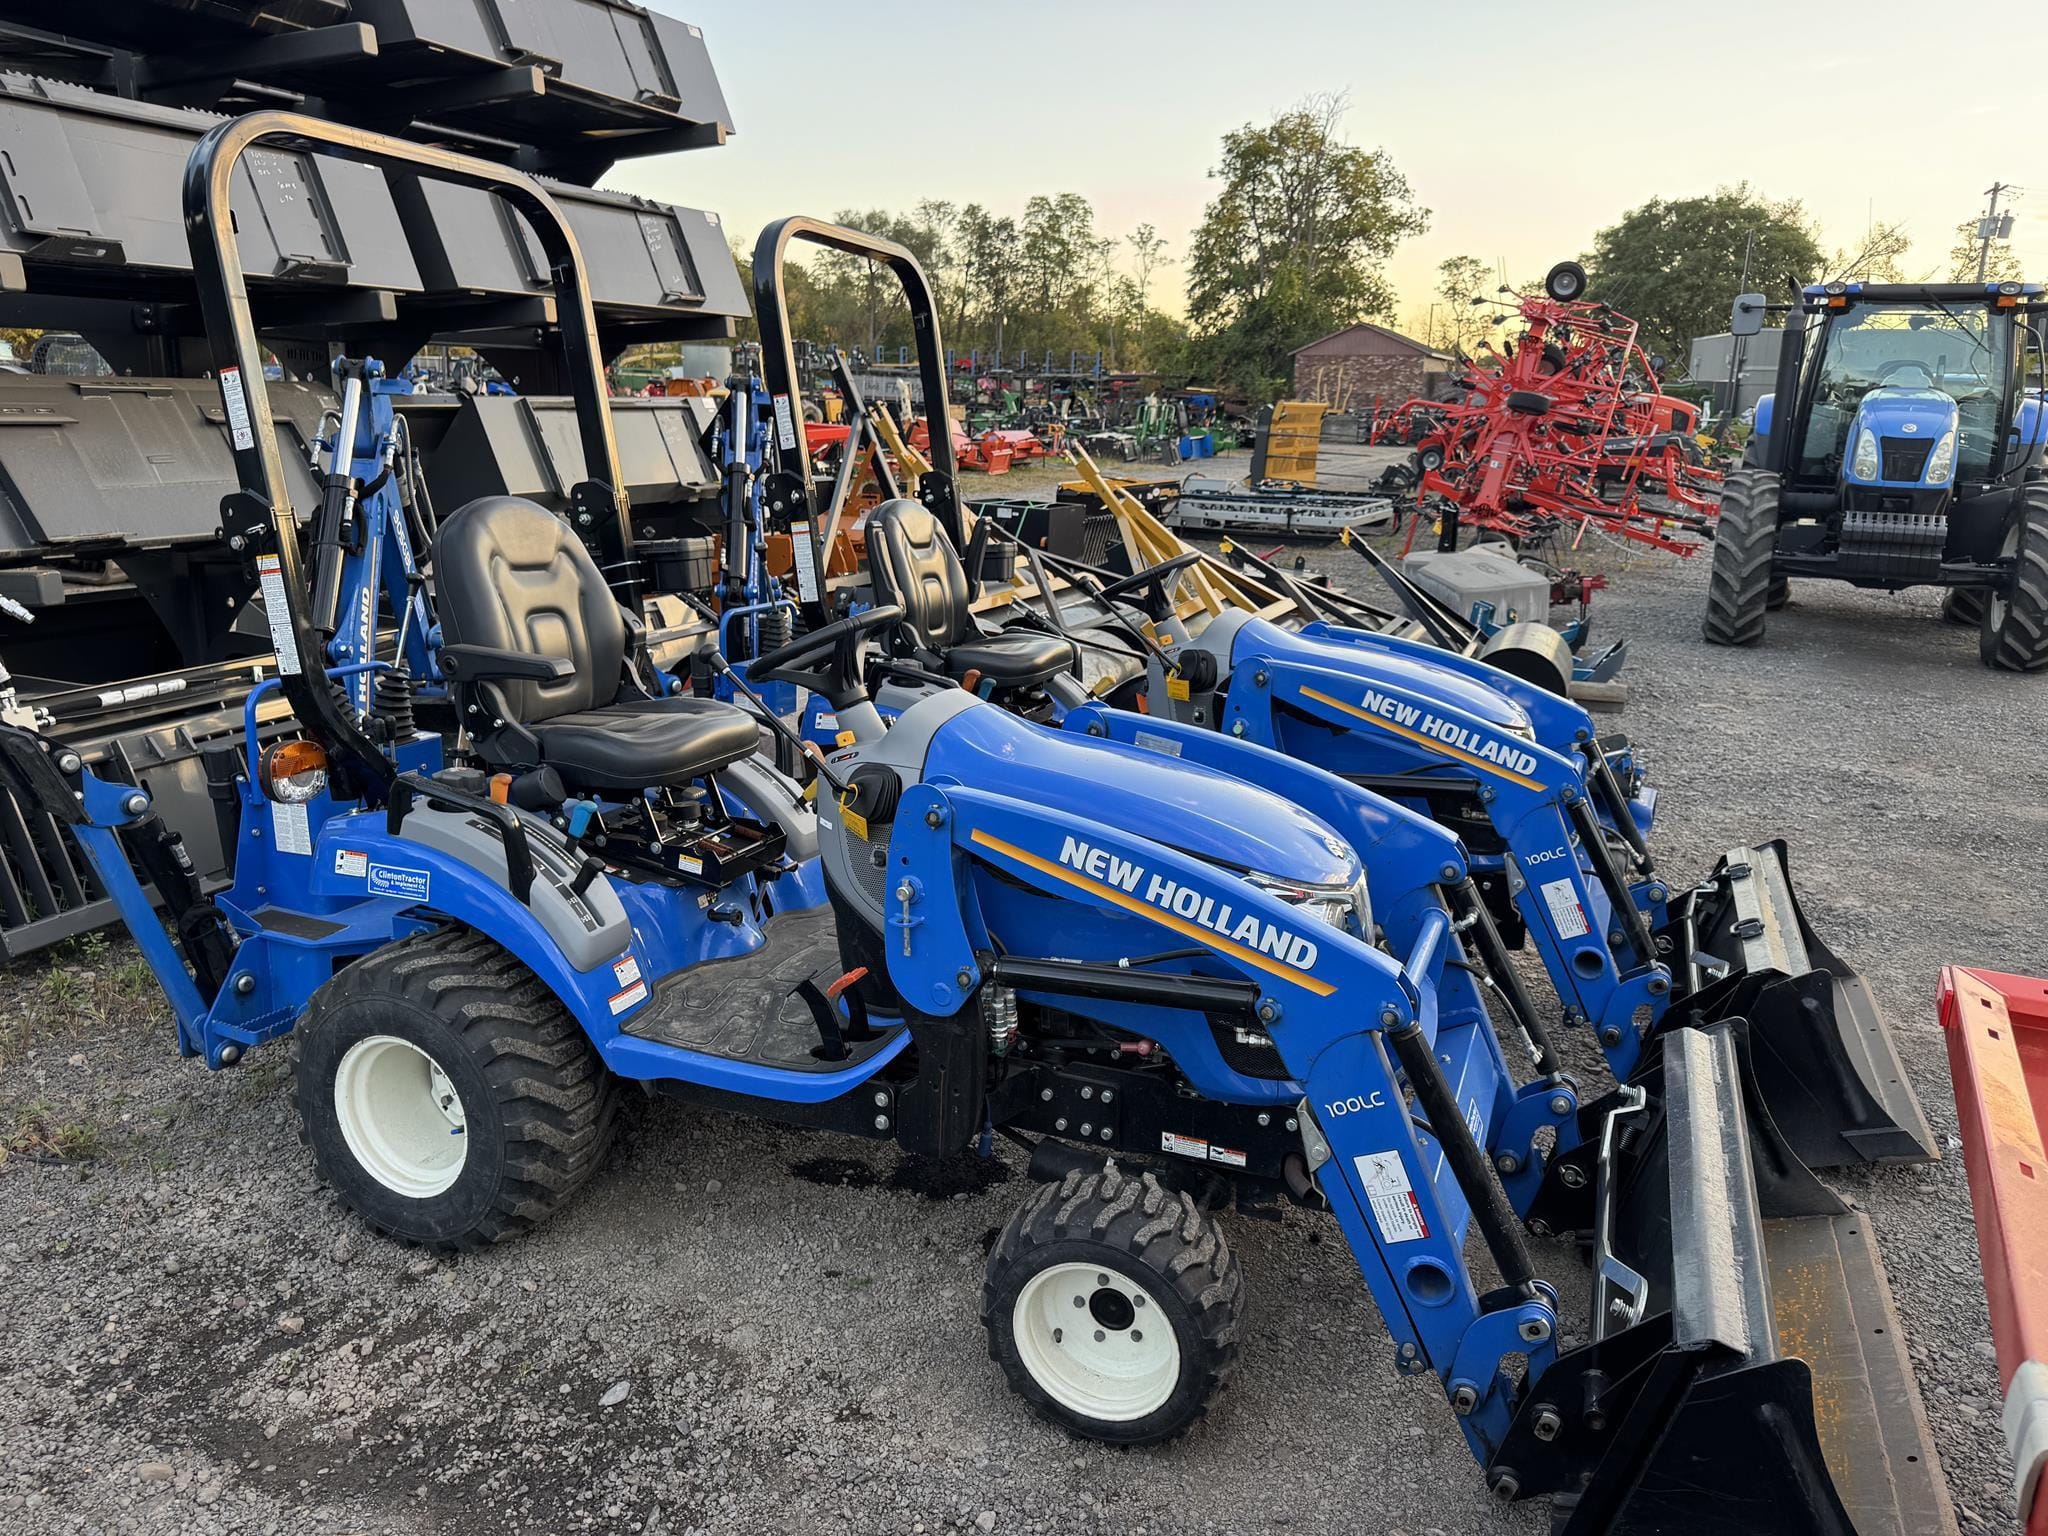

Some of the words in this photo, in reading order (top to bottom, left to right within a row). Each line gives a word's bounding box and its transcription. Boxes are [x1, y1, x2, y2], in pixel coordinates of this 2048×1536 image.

[1361, 690, 1422, 728] NEW
[1420, 715, 1538, 776] HOLLAND
[1524, 846, 1566, 866] 100LC
[378, 870, 426, 884] ClintonTractor
[1059, 835, 1144, 893] NEW
[1145, 874, 1318, 970] HOLLAND
[1325, 1091, 1385, 1118] 100LC
